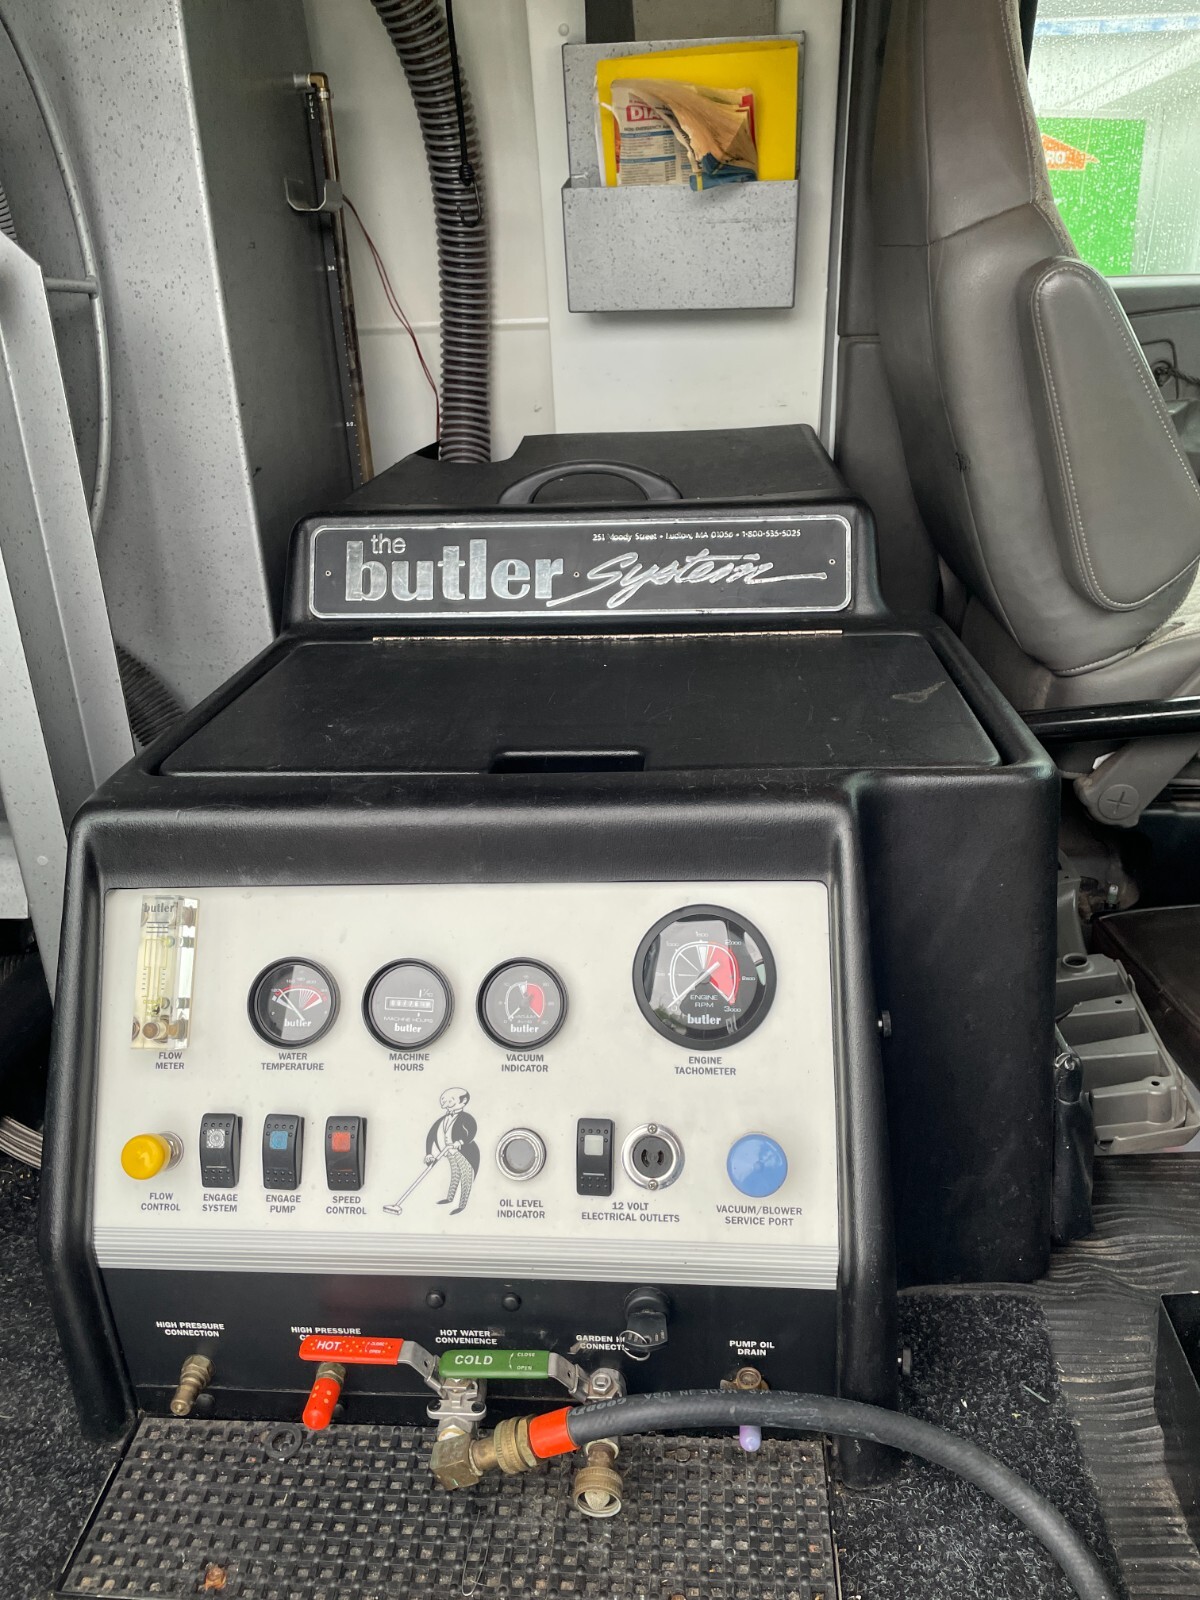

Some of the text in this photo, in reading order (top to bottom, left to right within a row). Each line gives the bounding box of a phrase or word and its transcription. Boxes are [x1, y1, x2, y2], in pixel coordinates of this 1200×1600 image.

[592, 533, 606, 542] 251
[634, 532, 658, 541] Street
[695, 531, 709, 539] MA
[371, 533, 407, 554] the
[345, 538, 564, 602] butler
[546, 548, 828, 609] System
[143, 902, 175, 913] butler
[723, 1005, 742, 1013] 3000
[284, 1018, 312, 1027] butler
[687, 1013, 722, 1025] butler
[394, 1022, 422, 1033] butler
[510, 1023, 540, 1033] butler
[158, 1051, 183, 1060] FLOW
[278, 1052, 308, 1061] WATER
[389, 1053, 431, 1061] MACHINE
[506, 1053, 544, 1062] VACUUM
[688, 1056, 723, 1065] ENGINE
[155, 1062, 185, 1070] METER
[261, 1062, 325, 1071] TEMPERATURE
[393, 1063, 425, 1072] HOURS
[501, 1064, 549, 1073] INDICATOR
[674, 1066, 737, 1076] TACHOMETER
[149, 1192, 174, 1200] FLOW
[203, 1193, 239, 1202] ENGAGE
[265, 1194, 302, 1203] ENGAGE
[332, 1195, 361, 1204] SPEED
[140, 1203, 181, 1211] CONTROL
[499, 1198, 544, 1208] OIL LEVEL
[611, 1202, 649, 1211] 12 VOLT
[202, 1204, 238, 1213] SYSTEM
[269, 1204, 296, 1214] PUMP
[325, 1206, 368, 1215] CONTROL
[716, 1204, 803, 1216] VACUUM/BLOWER
[496, 1209, 546, 1219] INDICATOR
[581, 1212, 680, 1223] ELECTRICAL OUTLETS
[724, 1216, 794, 1227] SERVICE PORT
[155, 1321, 225, 1330] HIGH PRESSURE
[164, 1328, 220, 1337] CONNECTION
[290, 1326, 362, 1335] HIGH PRESSURE
[459, 1329, 491, 1338] WATER
[435, 1336, 498, 1345] CONVENIENCE
[575, 1334, 614, 1343] GARDEN
[316, 1340, 342, 1351] HOT
[729, 1340, 776, 1349] PUMP OIL
[737, 1348, 767, 1356] DRAIN
[454, 1354, 493, 1365] COLD
[643, 1390, 672, 1400] USA
